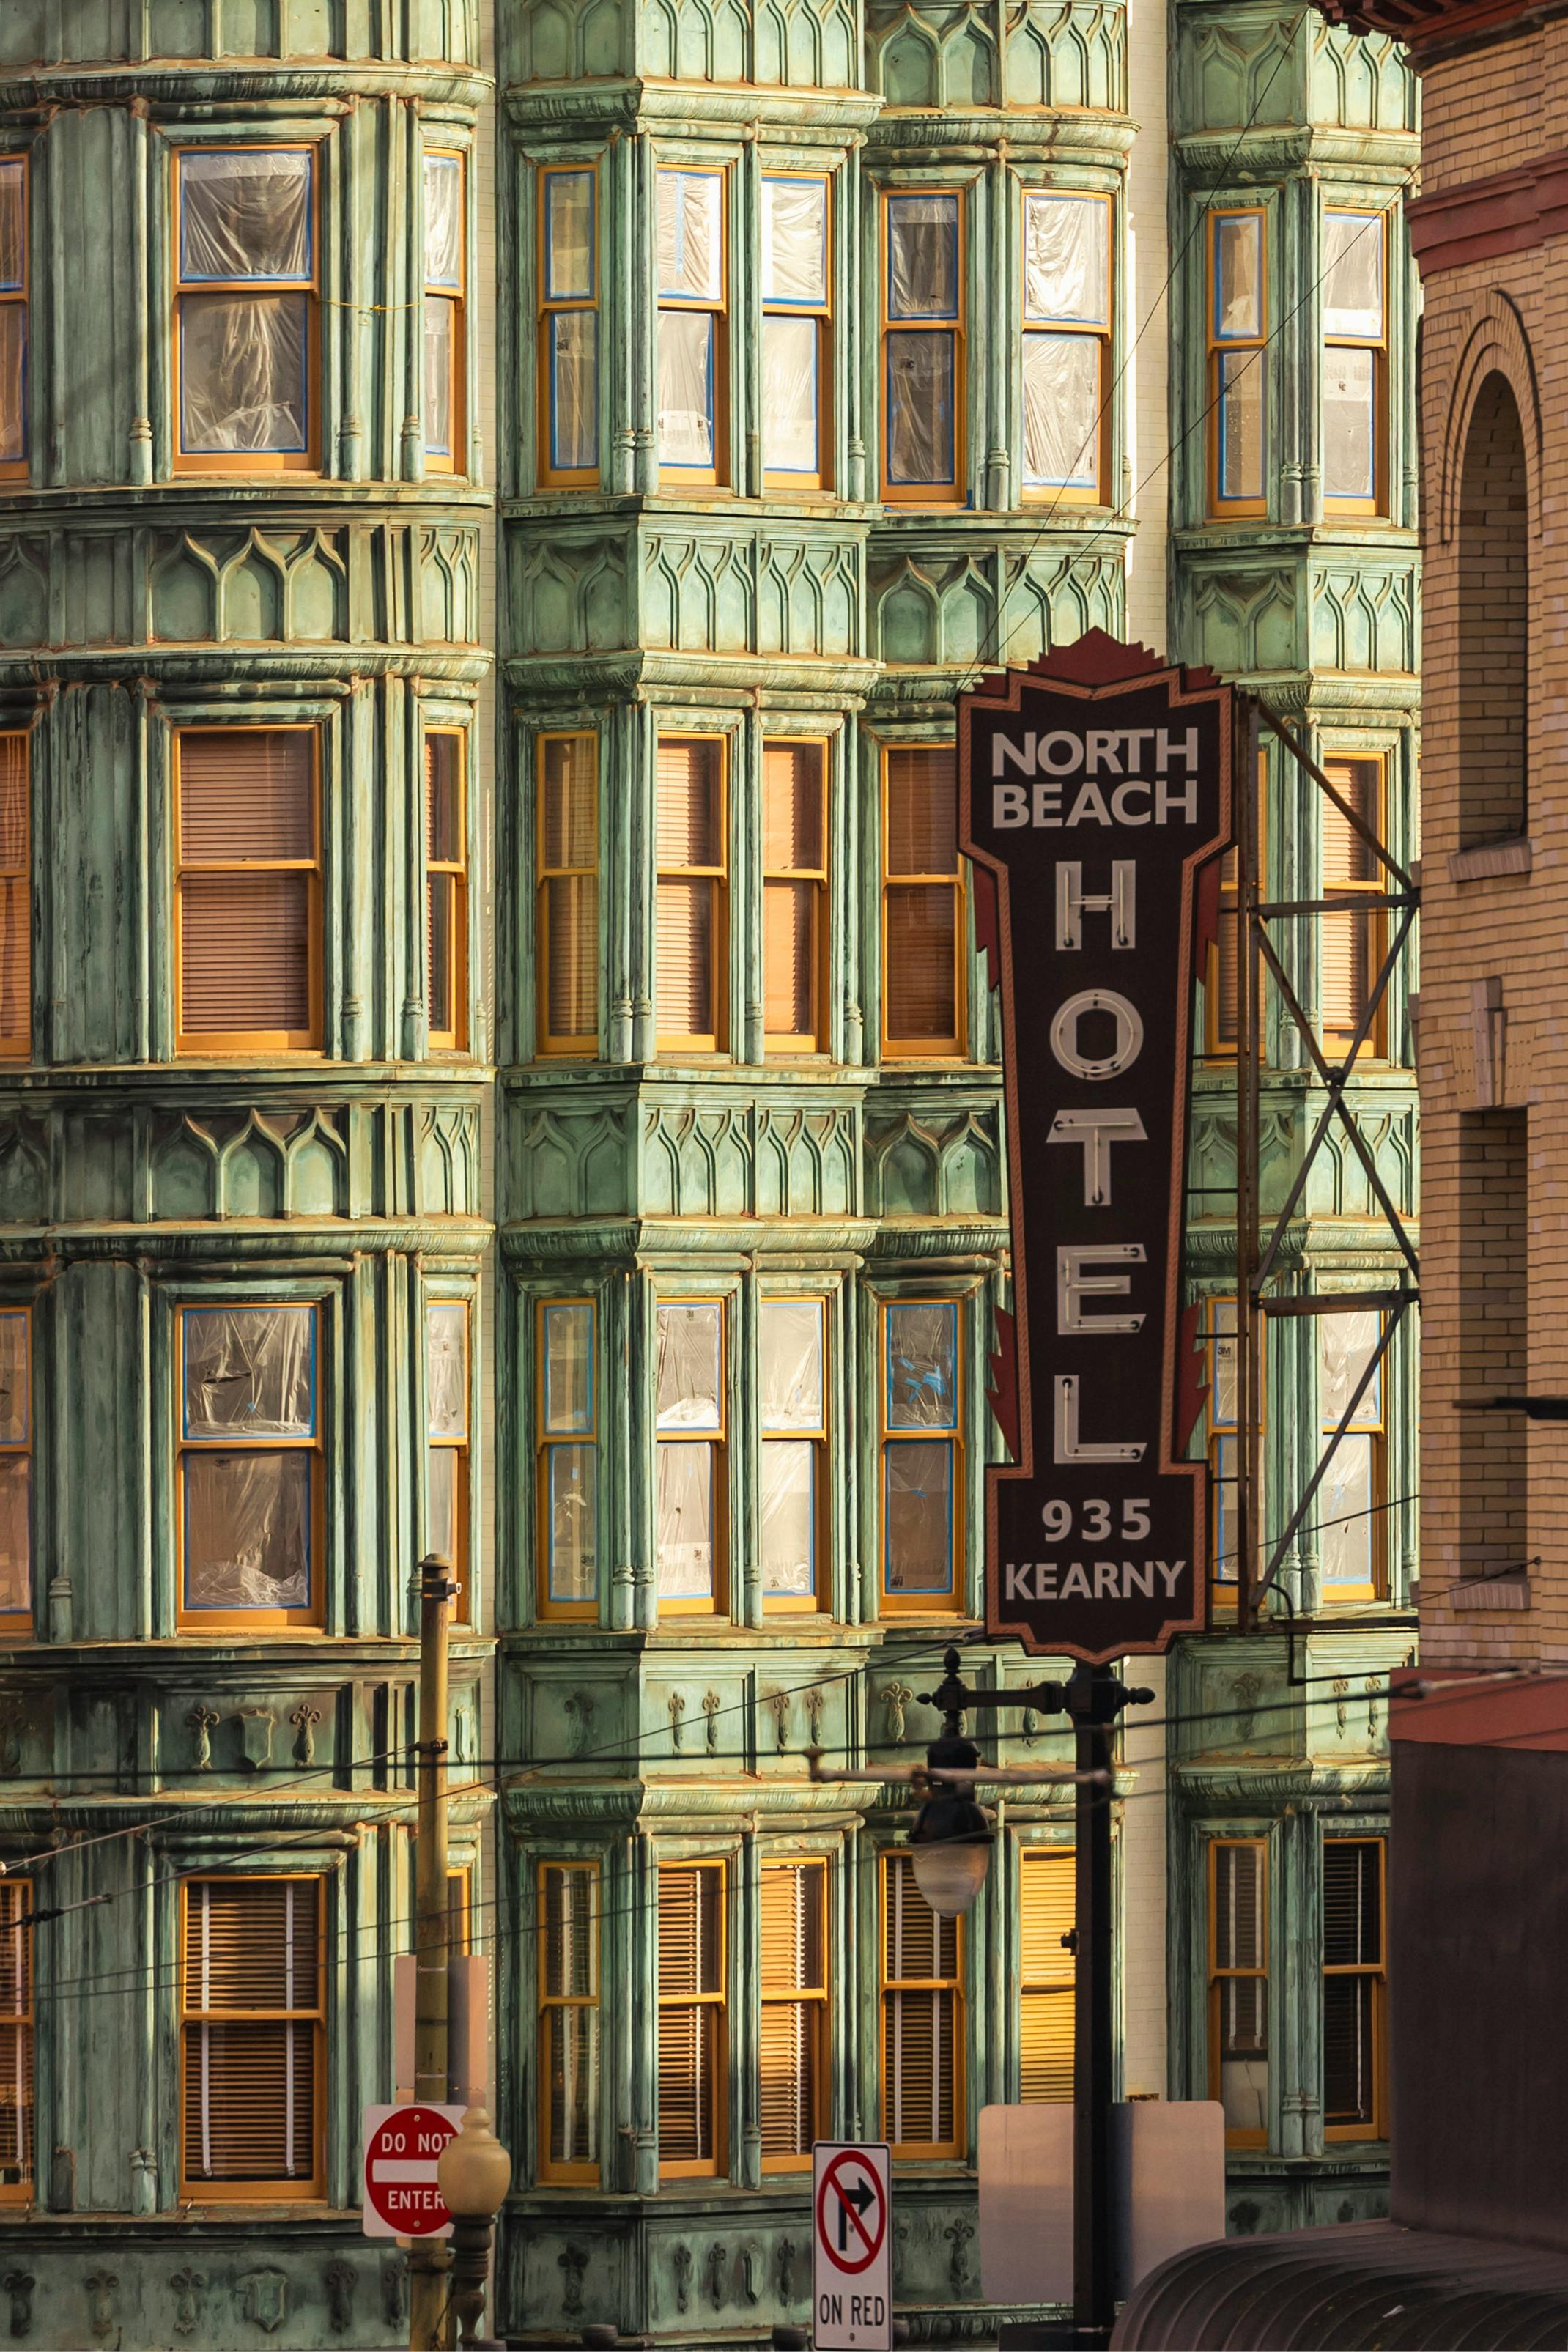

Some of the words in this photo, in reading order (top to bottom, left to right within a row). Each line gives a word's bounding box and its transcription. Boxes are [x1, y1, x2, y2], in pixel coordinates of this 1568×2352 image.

[992, 728, 1198, 777] NORTH
[992, 780, 1197, 828] BEACH
[1046, 860, 1149, 1463] HOTEL
[1218, 1347, 1231, 1355] 3M
[215, 1459, 230, 1468] 3M
[1042, 1498, 1150, 1542] 935
[581, 1554, 595, 1564] 3M
[1005, 1561, 1186, 1600] KEARNY
[381, 2133, 406, 2153] DO
[418, 2133, 453, 2153] NOT
[388, 2190, 445, 2210] ENTER
[819, 2293, 842, 2325] ON
[851, 2295, 884, 2326] RED
